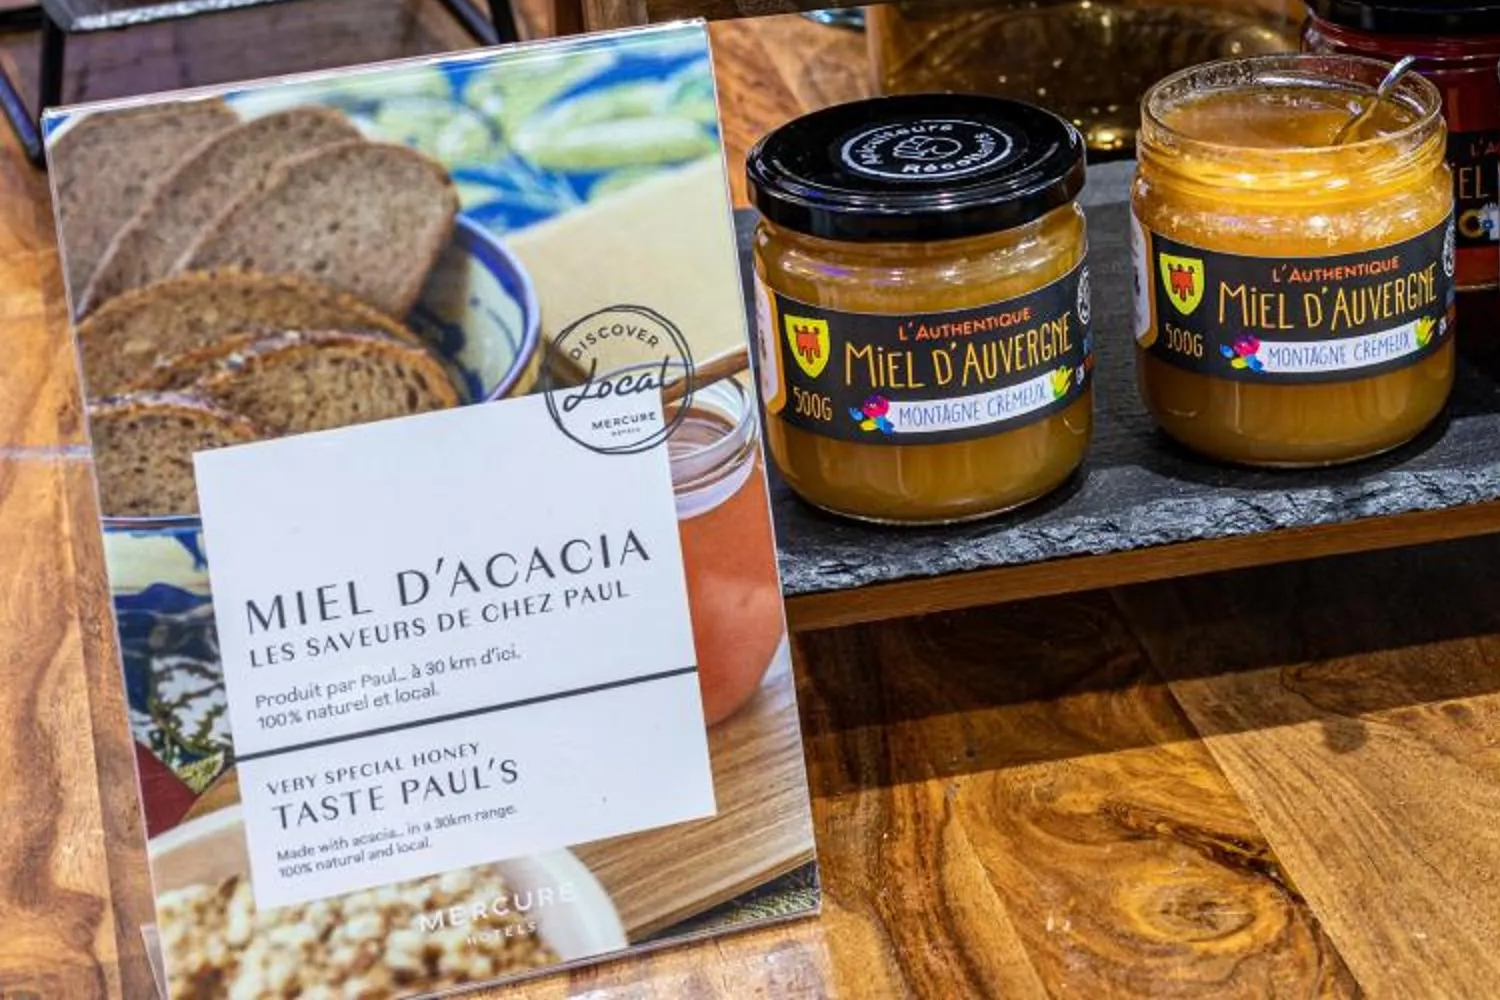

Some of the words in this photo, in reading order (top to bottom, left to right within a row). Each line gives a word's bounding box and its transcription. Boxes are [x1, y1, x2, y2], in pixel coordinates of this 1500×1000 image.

[1304, 261, 1437, 331] D'AUVERGNE
[570, 324, 658, 360] DISCOVER
[933, 311, 1073, 388] D'AUVERGNE
[1165, 323, 1204, 357] 500G
[1268, 345, 1346, 366] MONTAGNE
[563, 355, 679, 412] Local
[793, 385, 833, 422] 500G
[592, 412, 656, 430] MERCURE
[899, 398, 981, 428] MONTAGNE
[245, 580, 372, 635] MIEL
[397, 528, 651, 607] D'ACACIA
[250, 644, 296, 668] LES
[306, 617, 426, 658] SAVEURS
[437, 608, 470, 633] DE
[482, 594, 553, 623] CHEZ
[564, 579, 631, 609] PAUL
[255, 684, 322, 709] Produit
[327, 679, 356, 697] par
[412, 664, 422, 678] à
[425, 659, 445, 676] 30
[449, 654, 477, 671] km
[481, 648, 521, 665] d'ici.
[257, 711, 302, 729] 100%
[307, 697, 369, 720] naturel
[373, 692, 389, 706] et
[395, 683, 439, 704] local.
[267, 775, 317, 796] VERY
[325, 757, 403, 784] SPECIAL
[413, 742, 480, 766] HONEY
[272, 786, 385, 831] TASTE
[401, 758, 519, 804] PAUL'S
[276, 841, 315, 862] Made
[318, 834, 349, 853] with
[435, 811, 472, 830] 30km
[474, 804, 517, 824] range.
[279, 862, 313, 878] 100%
[316, 852, 365, 870] natural
[369, 844, 394, 860] and
[398, 837, 432, 854] local.
[416, 882, 577, 935] MERCURE
